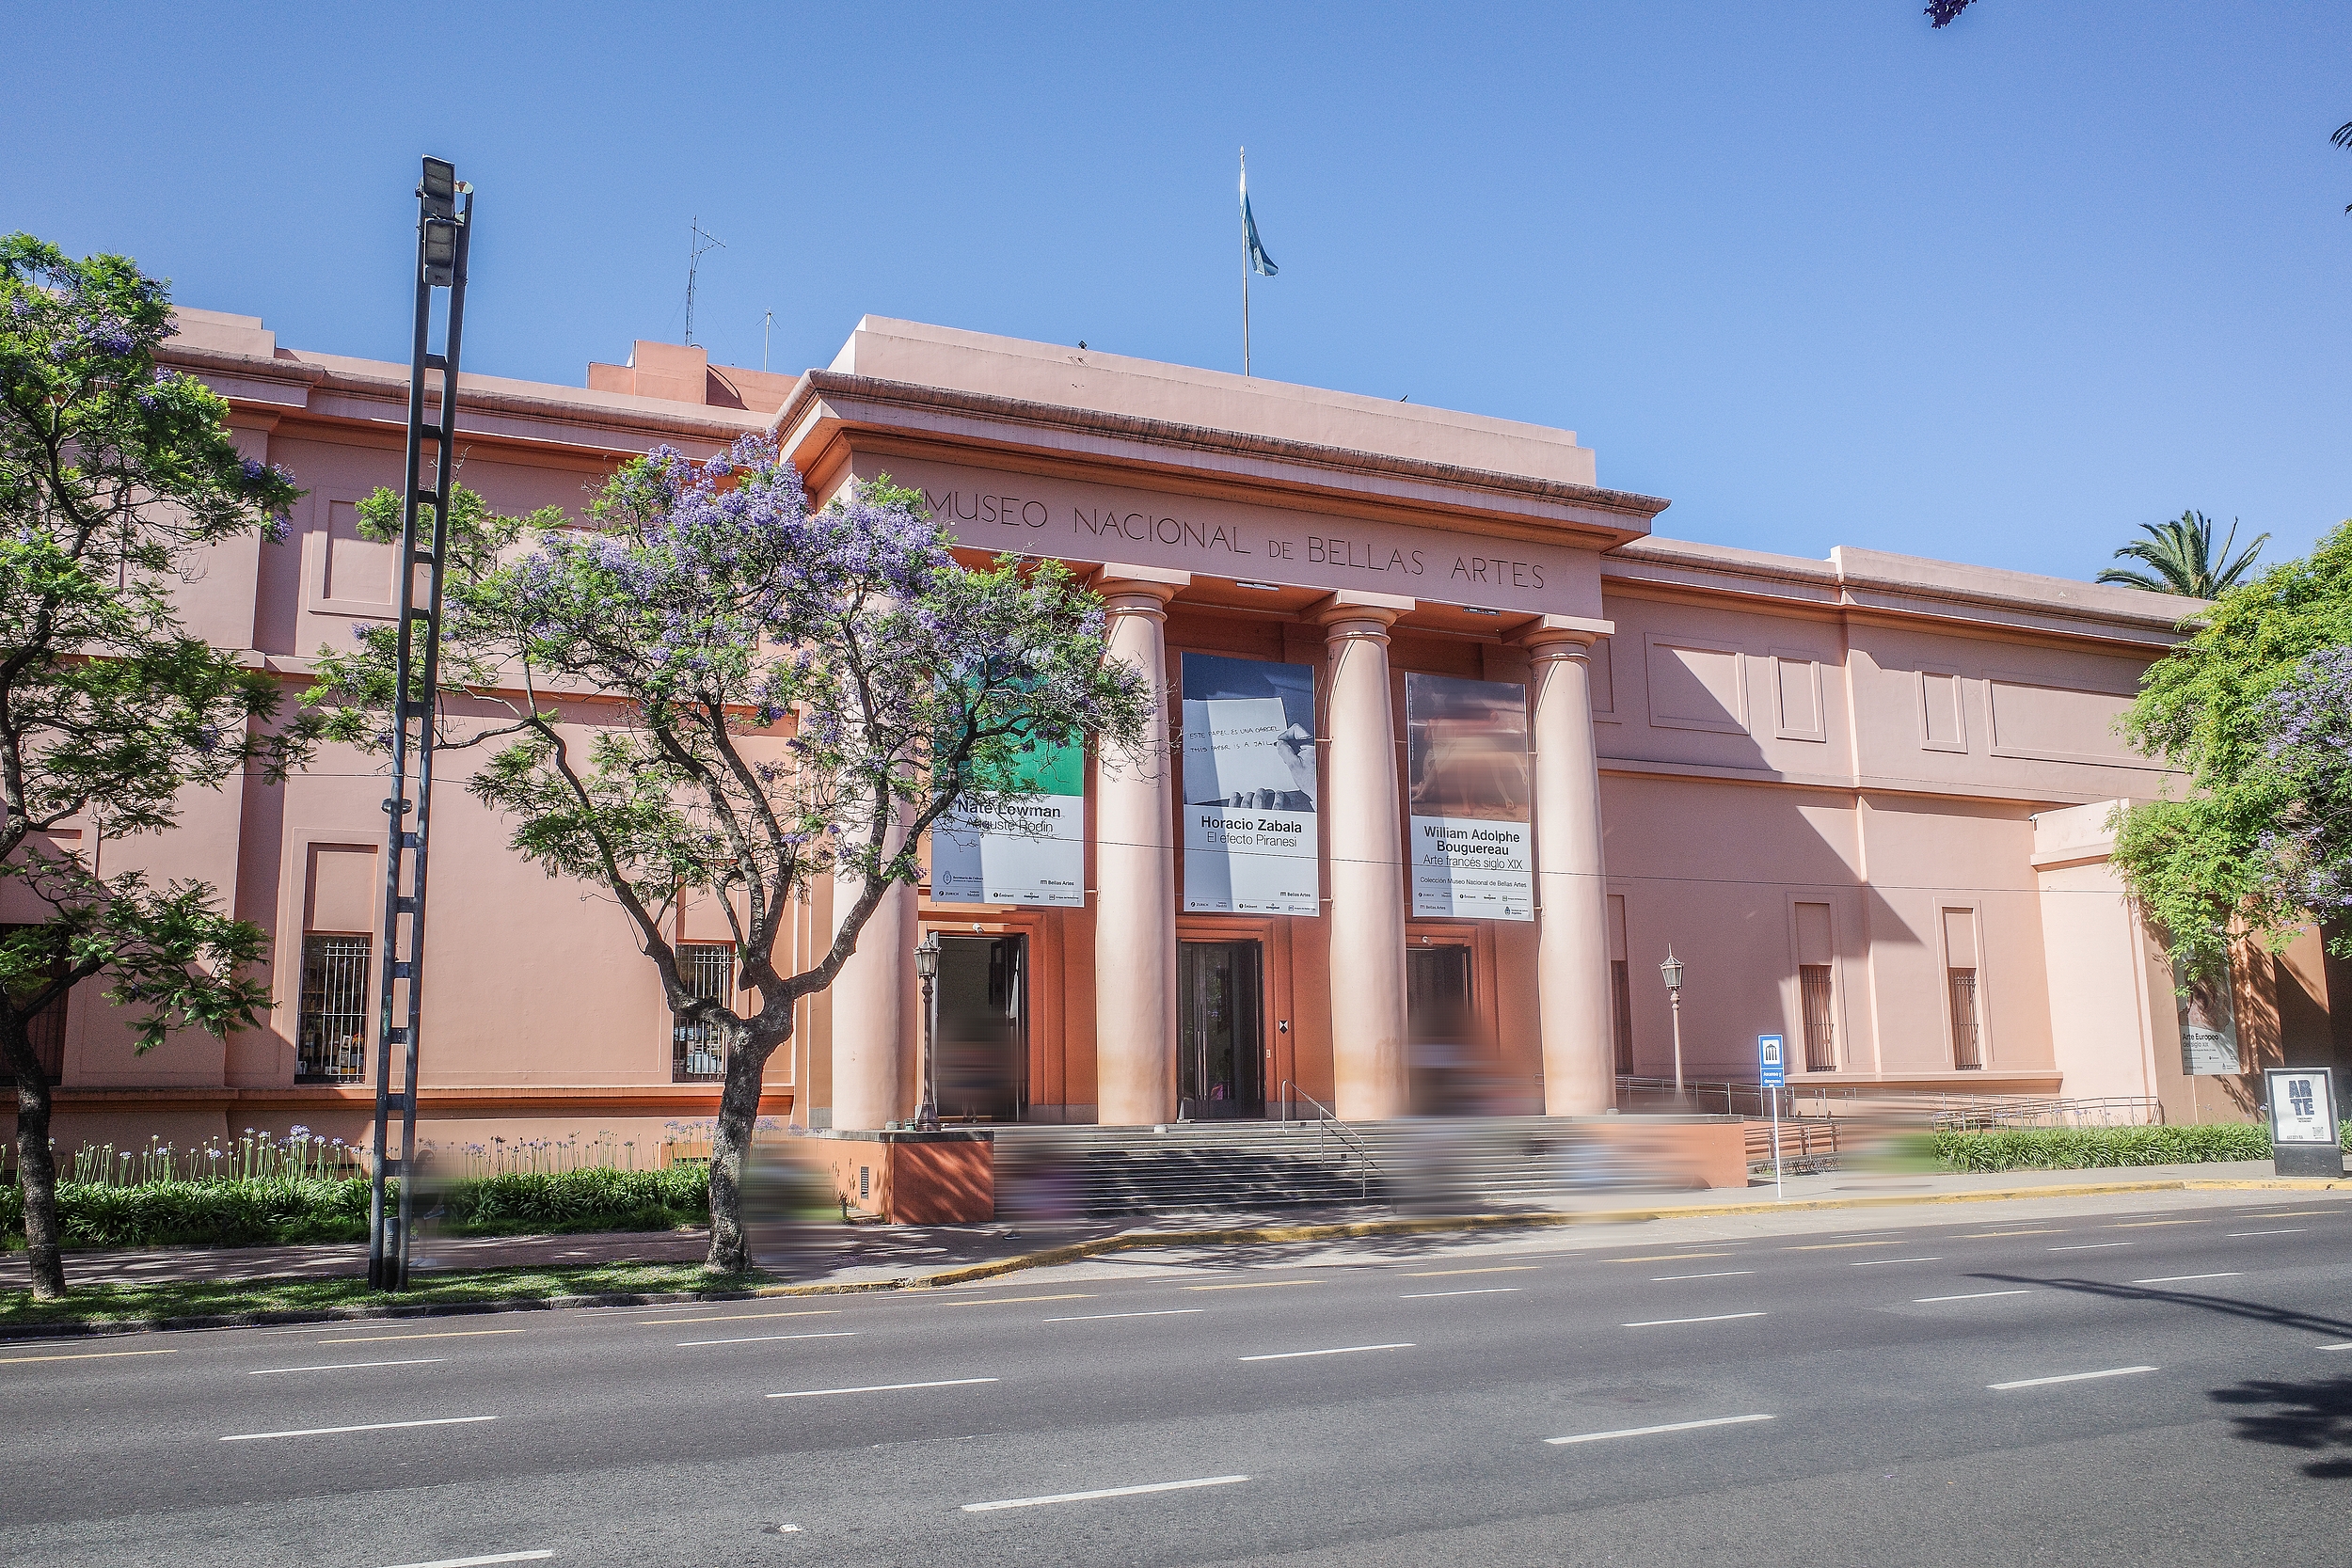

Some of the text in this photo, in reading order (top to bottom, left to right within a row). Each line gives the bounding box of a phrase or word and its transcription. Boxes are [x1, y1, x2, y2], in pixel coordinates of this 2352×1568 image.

[925, 489, 1545, 590] MUSEO NACIONAL DE BELLAS ARTES
[958, 799, 1061, 817] Nate Lowman
[1019, 819, 1053, 832] Rodin
[1200, 816, 1302, 832] Horacio Zabala
[1207, 832, 1297, 847] El efecto Piranesi
[1423, 826, 1520, 844] William Adolphe
[1437, 840, 1509, 855] Bouguereau
[1422, 854, 1523, 870] Arte francés siglo XIX
[2195, 1033, 2219, 1041] Europeo
[2289, 1080, 2313, 1099] AR
[2290, 1098, 2314, 1116] TE
